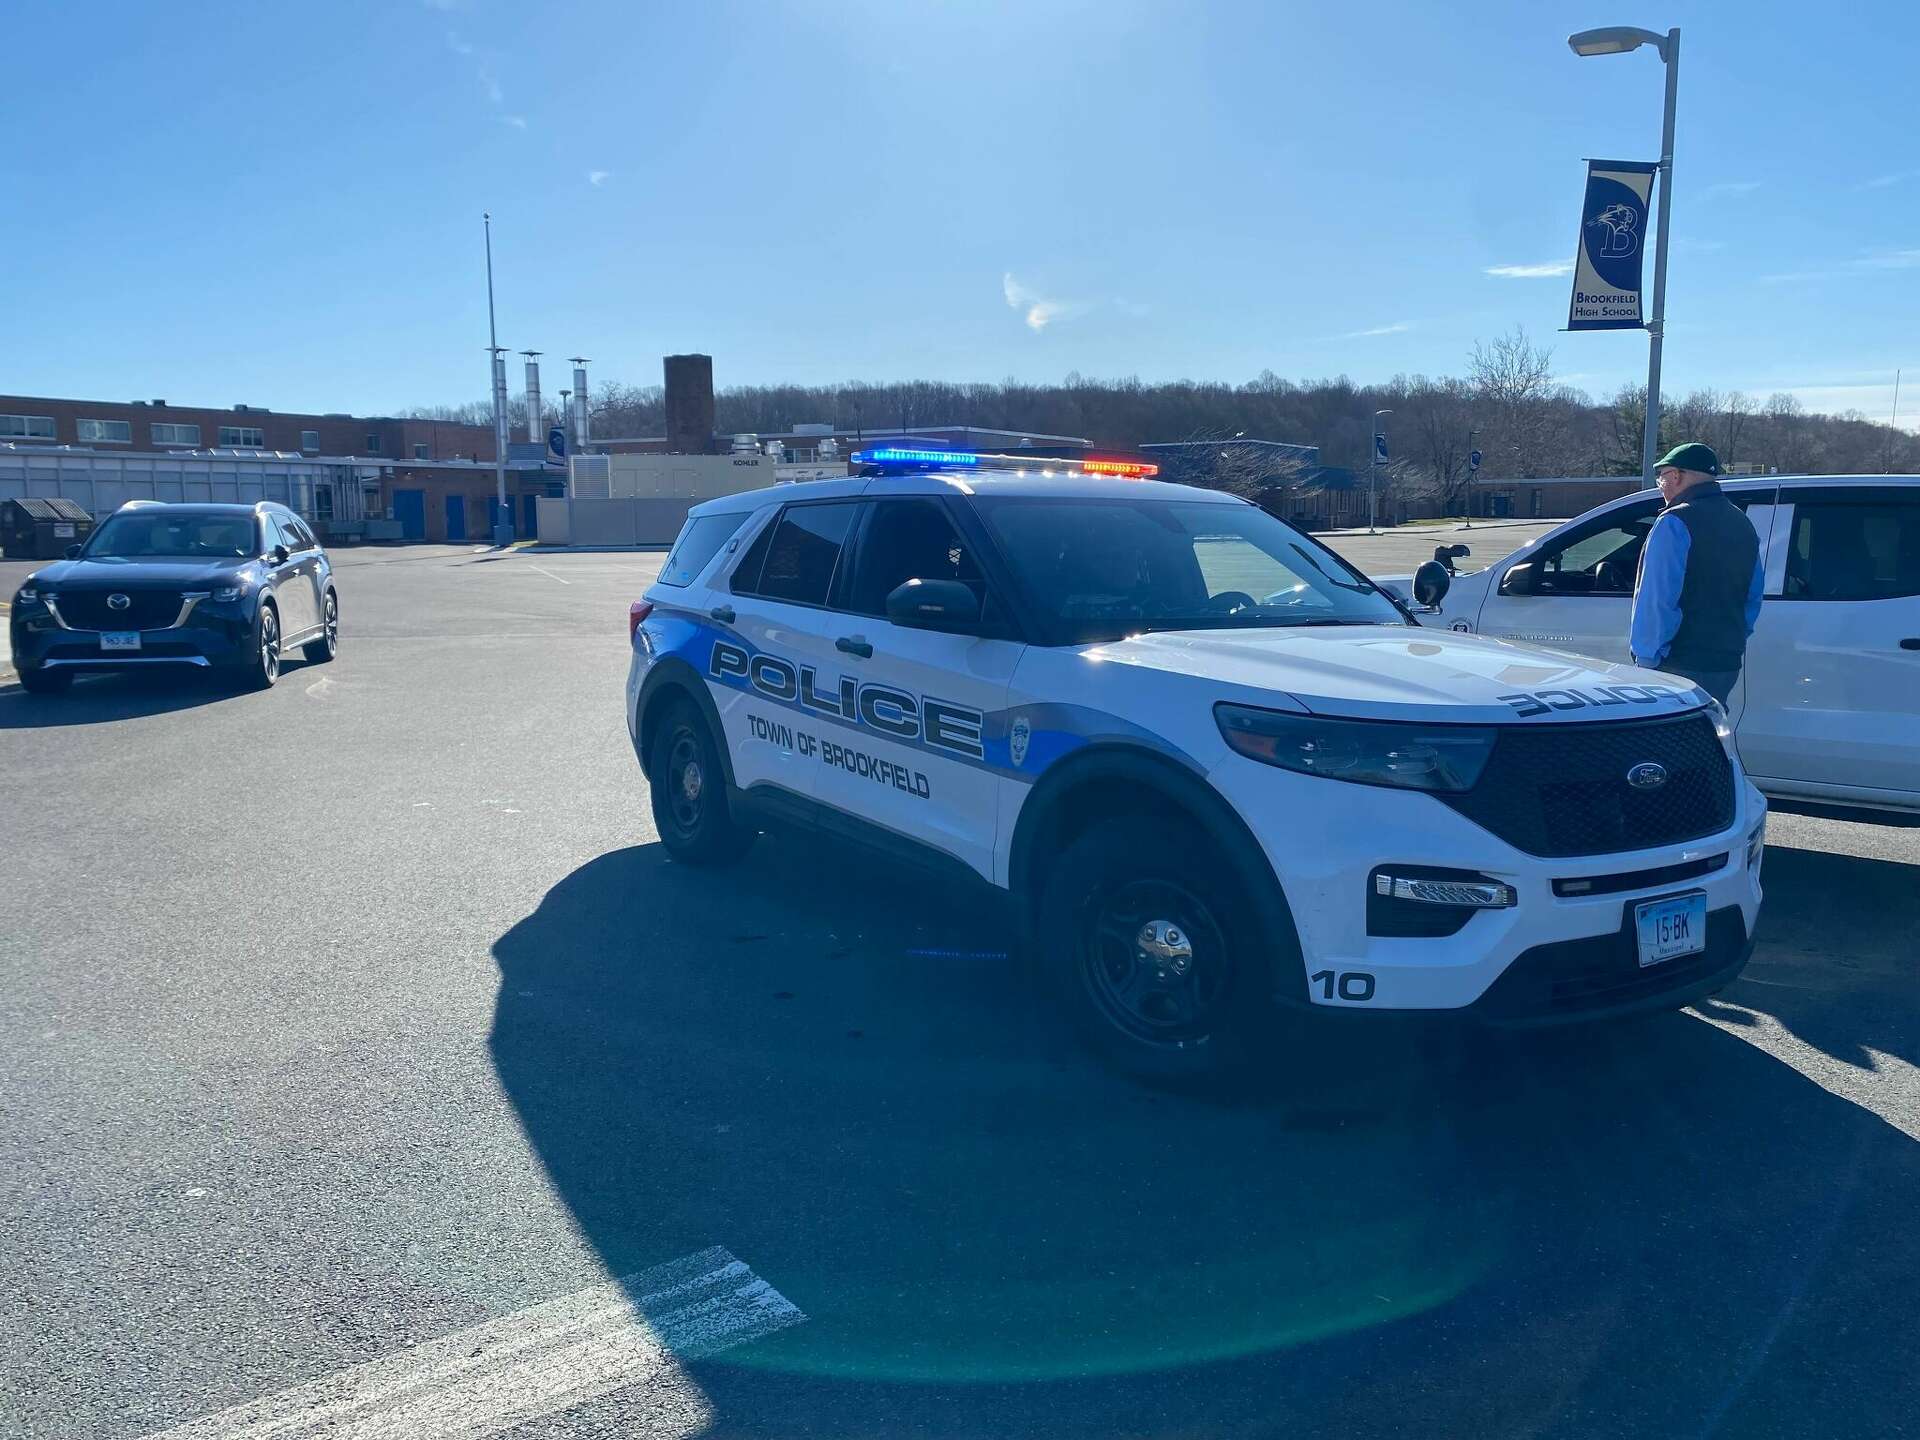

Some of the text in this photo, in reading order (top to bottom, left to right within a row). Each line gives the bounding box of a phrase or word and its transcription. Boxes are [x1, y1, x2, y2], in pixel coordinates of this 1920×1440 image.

[1575, 306, 1637, 317] HIGH SCHOOL
[1576, 292, 1636, 304] BROOKFIELD
[710, 639, 985, 761] POLICE
[747, 714, 930, 800] TOWN OF BROOKFIELD
[1311, 970, 1375, 1001] 10
